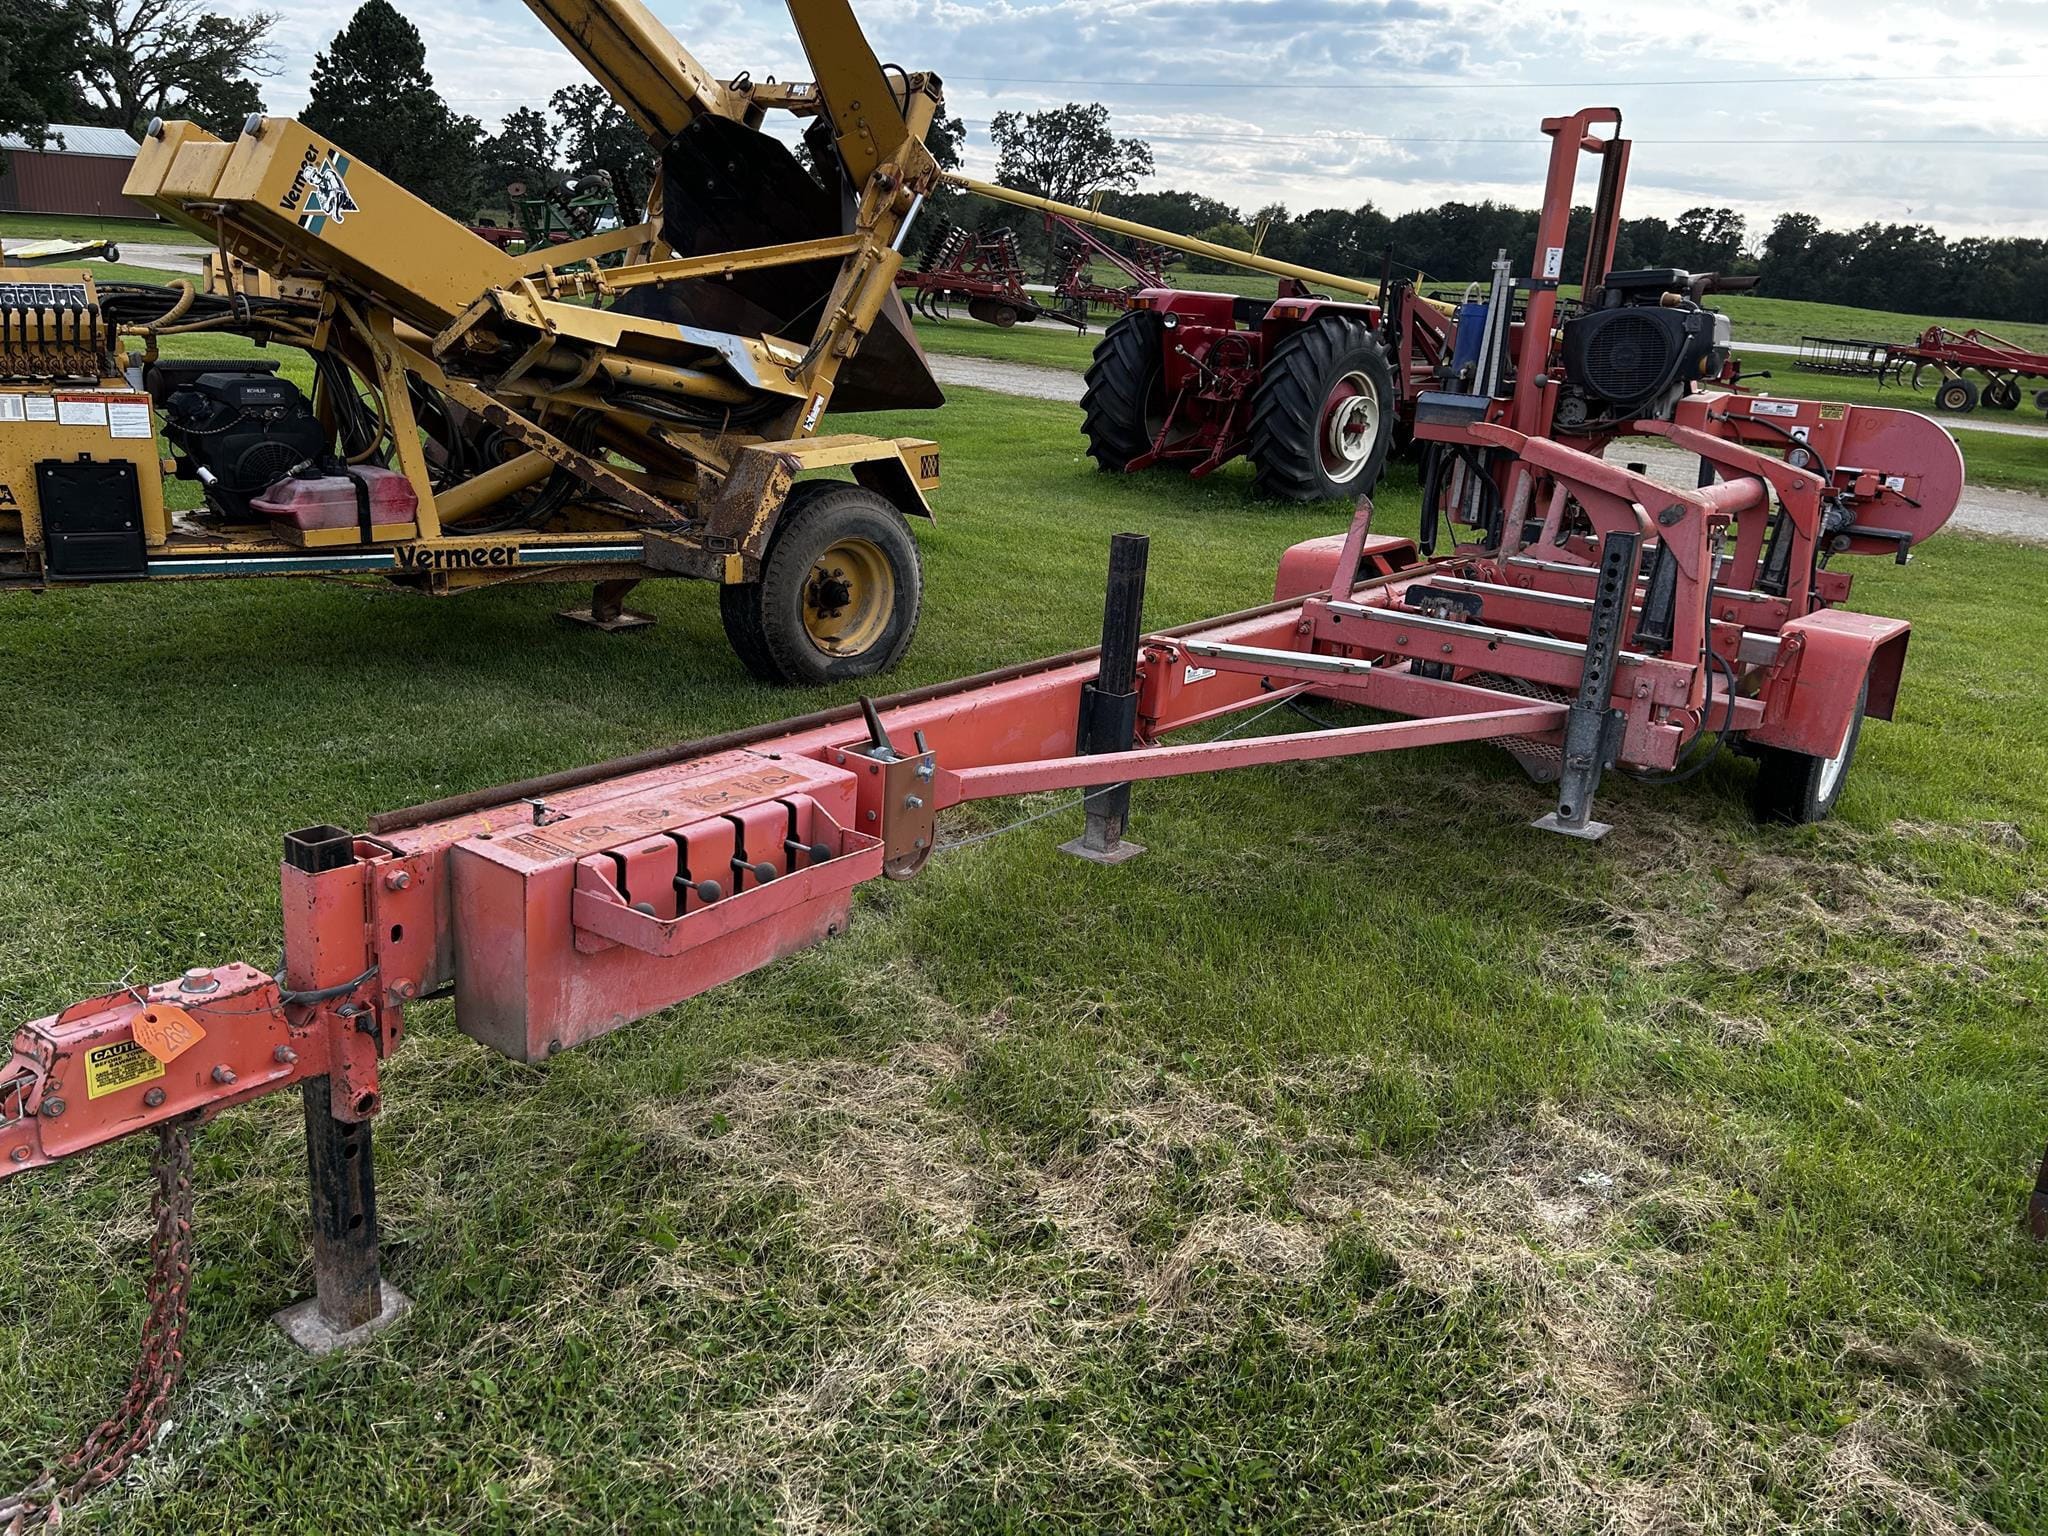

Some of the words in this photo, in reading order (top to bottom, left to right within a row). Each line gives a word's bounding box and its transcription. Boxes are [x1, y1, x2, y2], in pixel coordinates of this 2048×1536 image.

[396, 545, 517, 569] Vermeer
[155, 1020, 194, 1053] 269
[94, 1041, 141, 1061] CAUTI
[95, 1055, 123, 1068] BEFORE
[109, 1055, 141, 1068] SAWMILL
